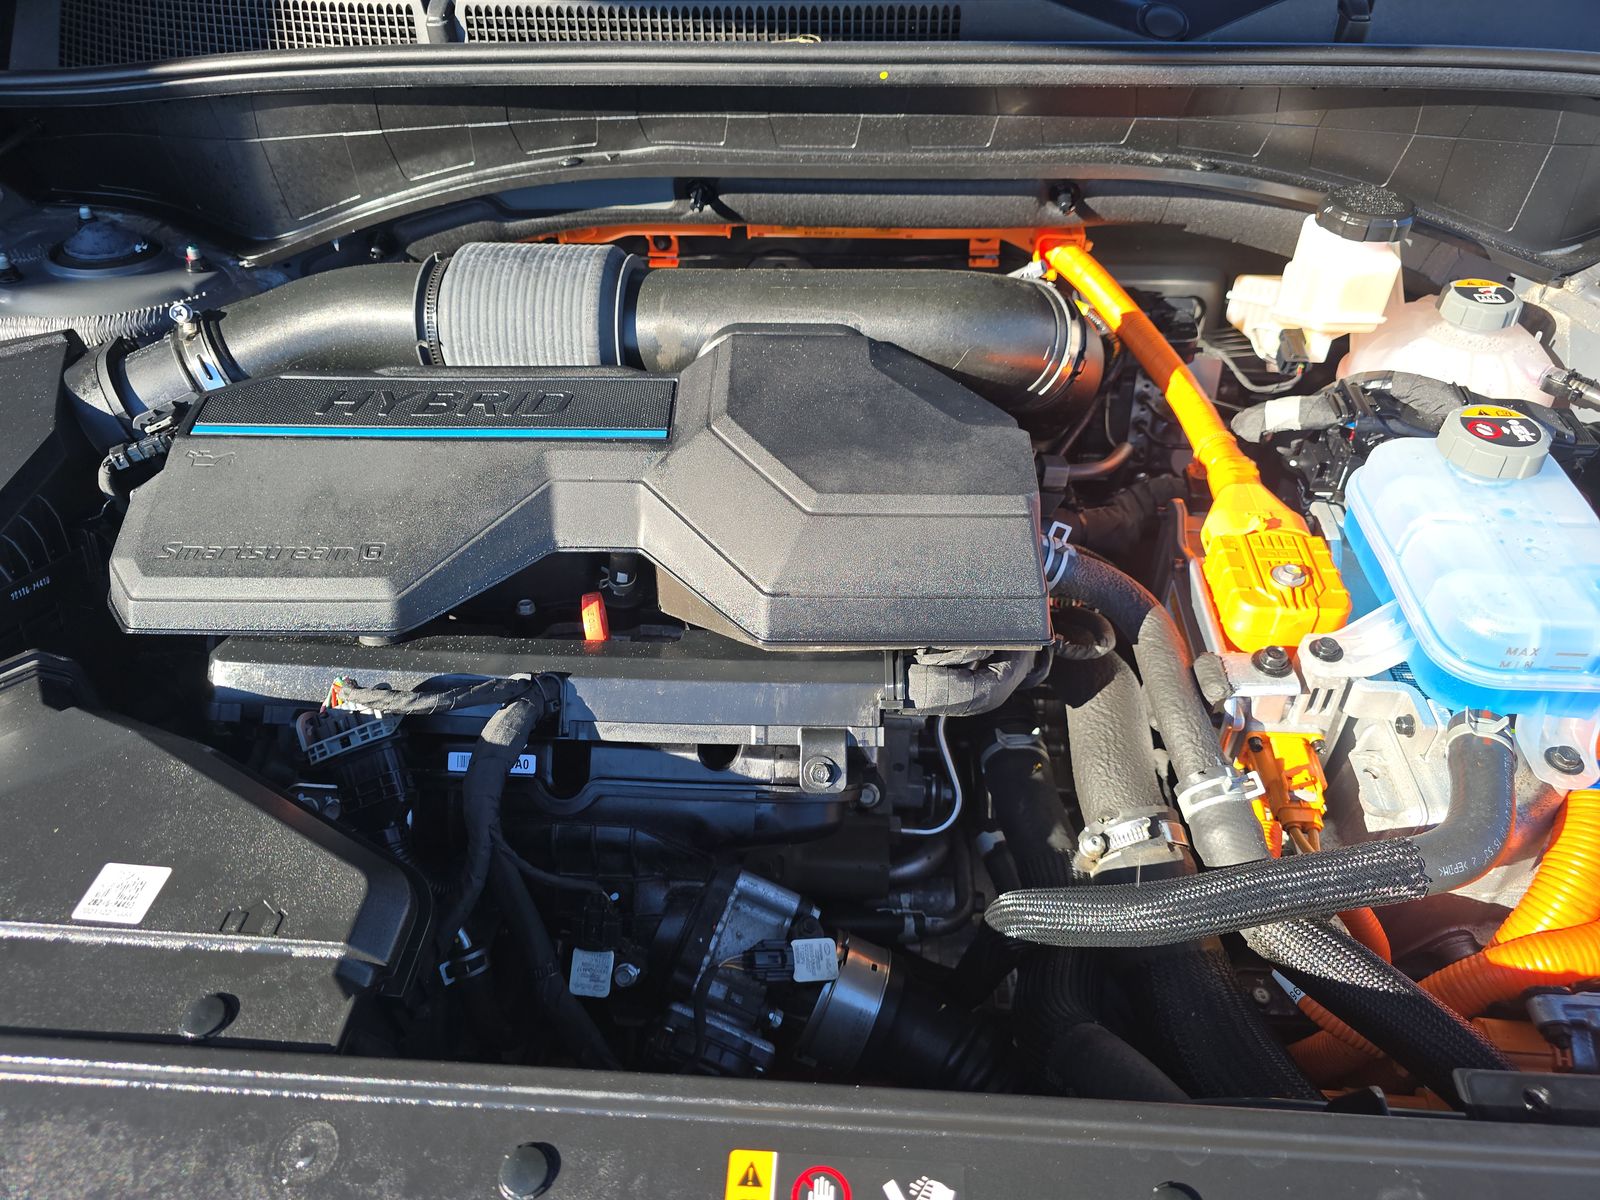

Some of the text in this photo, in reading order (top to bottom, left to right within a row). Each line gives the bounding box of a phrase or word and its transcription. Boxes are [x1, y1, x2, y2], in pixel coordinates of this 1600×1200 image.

[315, 389, 574, 417] HYBRID
[157, 541, 354, 561] Smartstream
[1505, 646, 1542, 657] MAX
[1499, 660, 1534, 670] MIN
